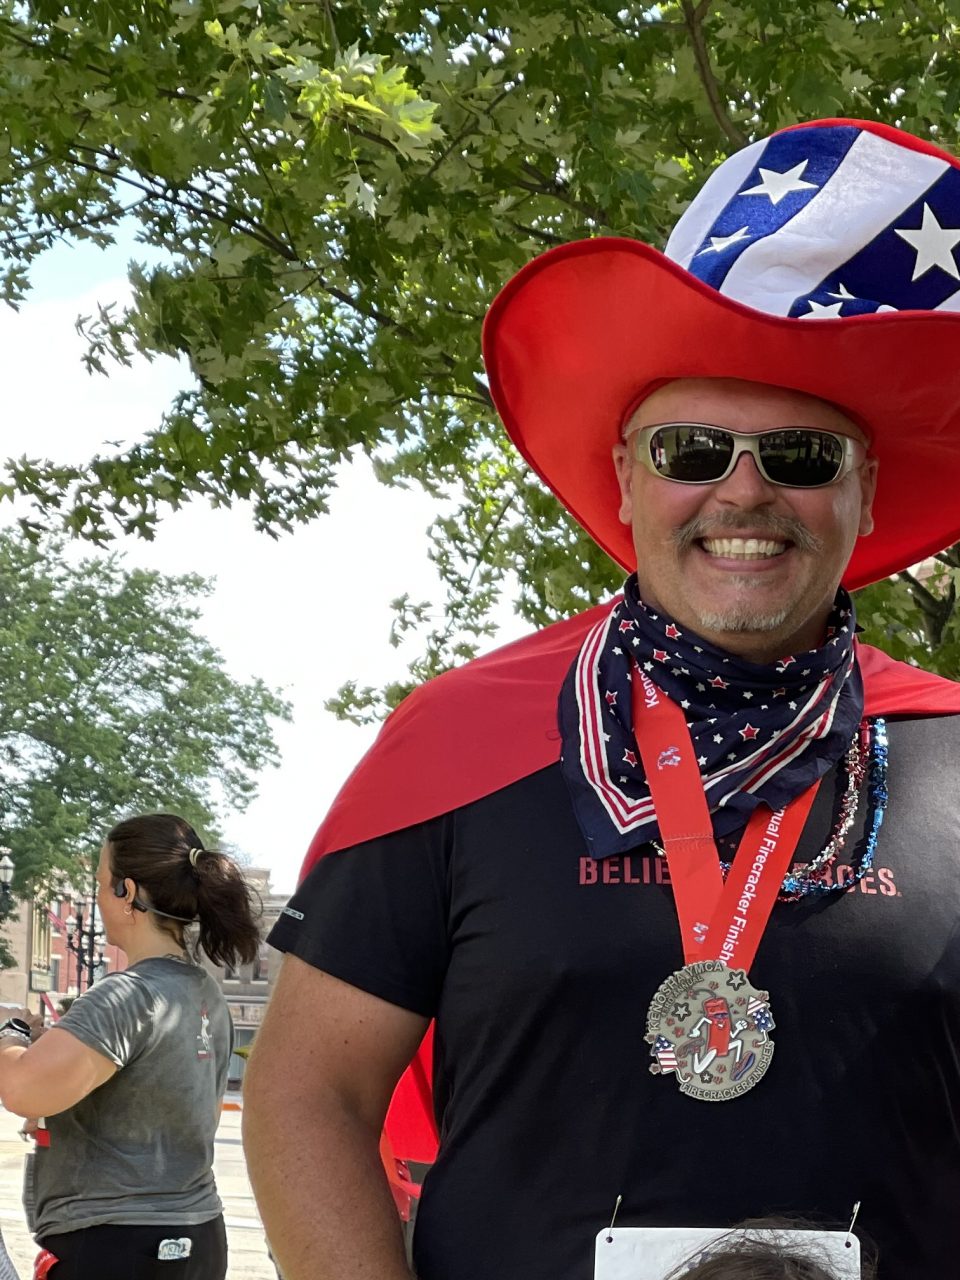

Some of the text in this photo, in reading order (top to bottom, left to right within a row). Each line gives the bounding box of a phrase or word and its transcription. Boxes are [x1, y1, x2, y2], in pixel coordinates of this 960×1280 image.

[736, 838, 776, 915] Firecracker
[650, 961, 724, 1031] KENOSHA YMCA
[680, 1041, 775, 1101] FIRECRACKER FINISHER
